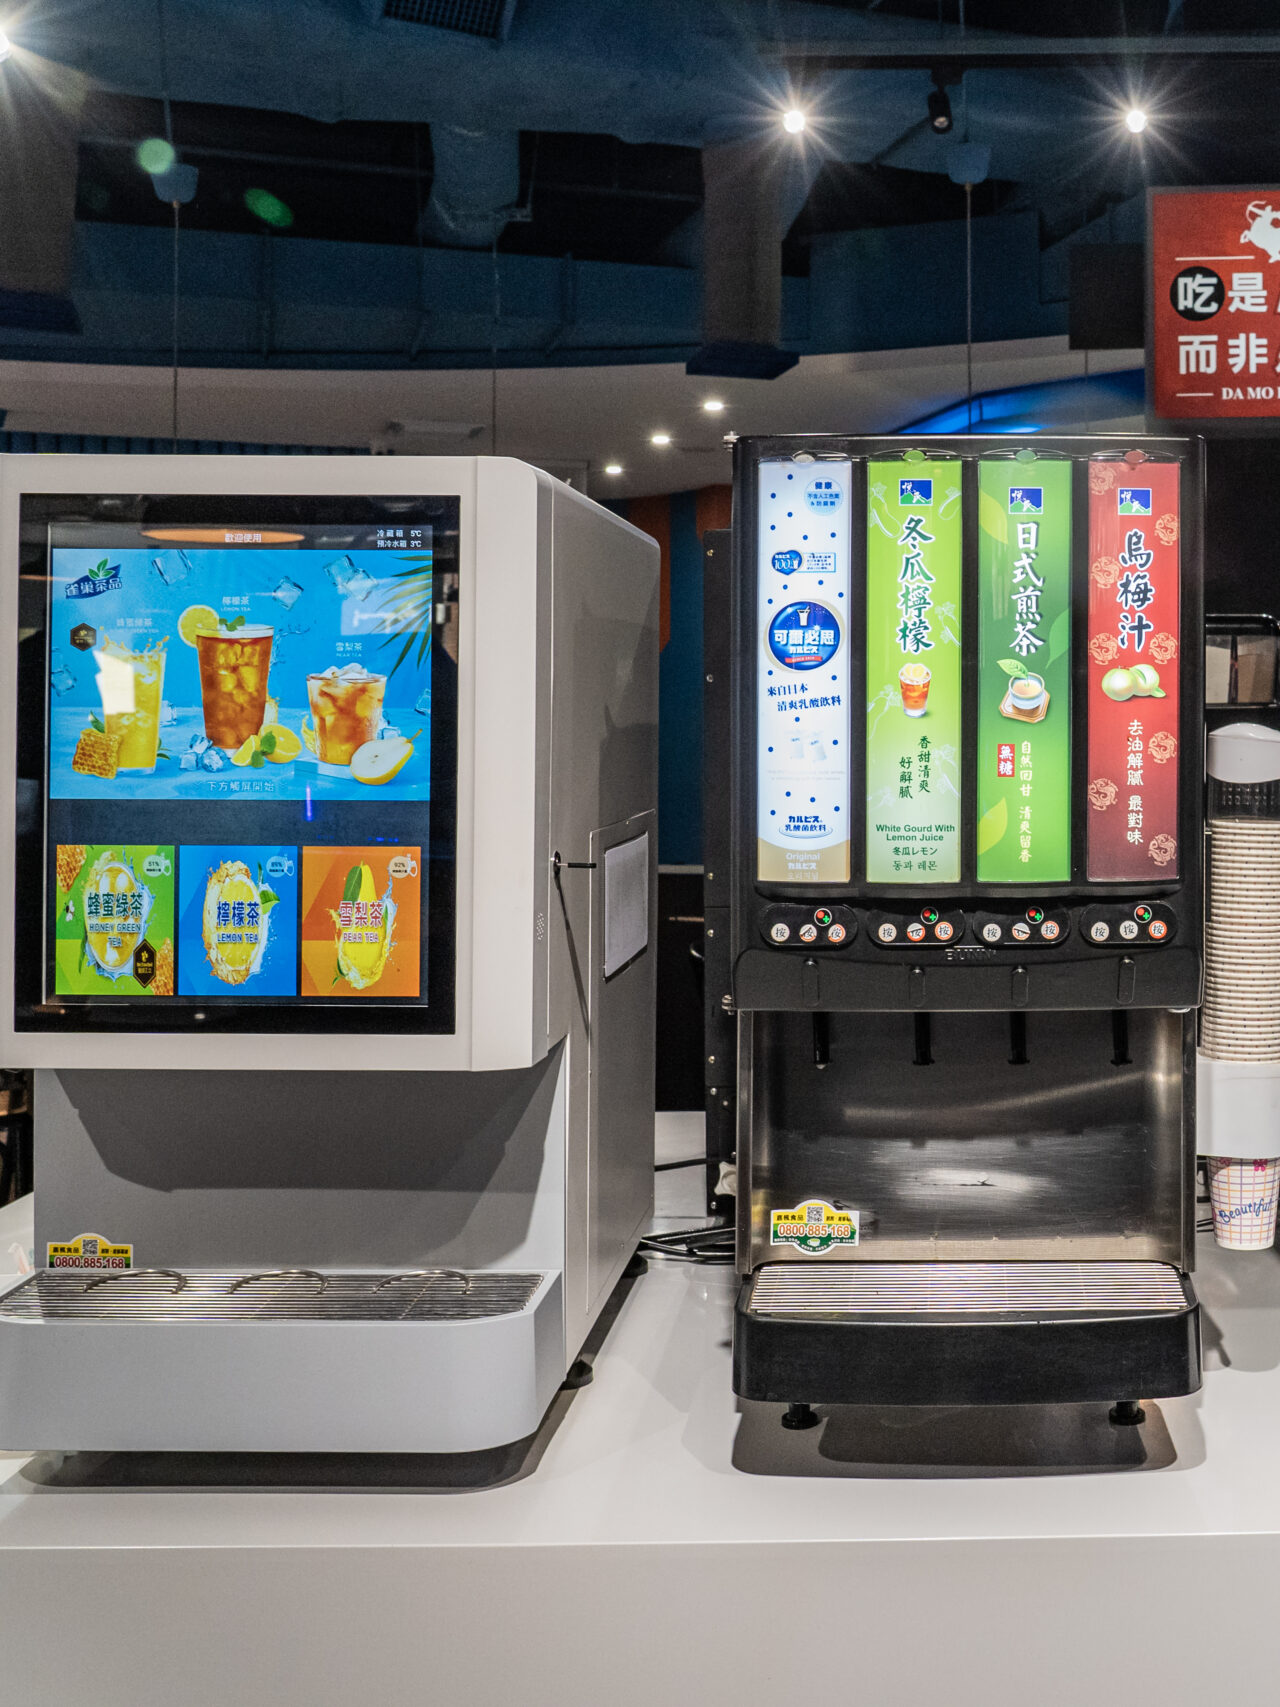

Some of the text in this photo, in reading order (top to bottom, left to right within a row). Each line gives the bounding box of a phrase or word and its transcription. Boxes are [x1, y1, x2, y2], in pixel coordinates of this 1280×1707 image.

[1222, 387, 1244, 400] DA
[1247, 387, 1274, 400] MO
[65, 577, 122, 597] 雀巢茶品
[897, 515, 936, 654] 冬瓜檸檬
[1009, 521, 1045, 657] 日式煎茶
[1116, 529, 1155, 652] 烏梅汁
[773, 629, 835, 645] 可爾必思
[767, 683, 808, 696] 來自日本
[777, 695, 841, 711] 清爽乳酸飲料
[918, 735, 931, 793] 香甜清爽
[999, 745, 1014, 776] 無糖
[899, 756, 913, 799] 好解膩
[1126, 719, 1144, 845] 去油解膩 最對味
[1019, 740, 1033, 863] 自然回甘 清爽留香
[788, 815, 820, 823] カルピス
[785, 824, 826, 832] 乳酸菌飲料
[876, 824, 955, 832] White Gourd With
[886, 833, 944, 841] Lemon Juice
[786, 853, 820, 862] Original
[892, 847, 938, 856] 冬瓜レモン
[892, 860, 937, 871] 동과 레몬
[87, 892, 143, 917] 蜂蜜綠茶
[217, 901, 260, 927] 檸檬茶
[340, 901, 383, 927] 雪梨茶
[89, 923, 141, 932] HONEY GREEN
[108, 937, 122, 946] TEA
[217, 933, 259, 942] LEMON TEA
[343, 932, 379, 942] PEAR TEA
